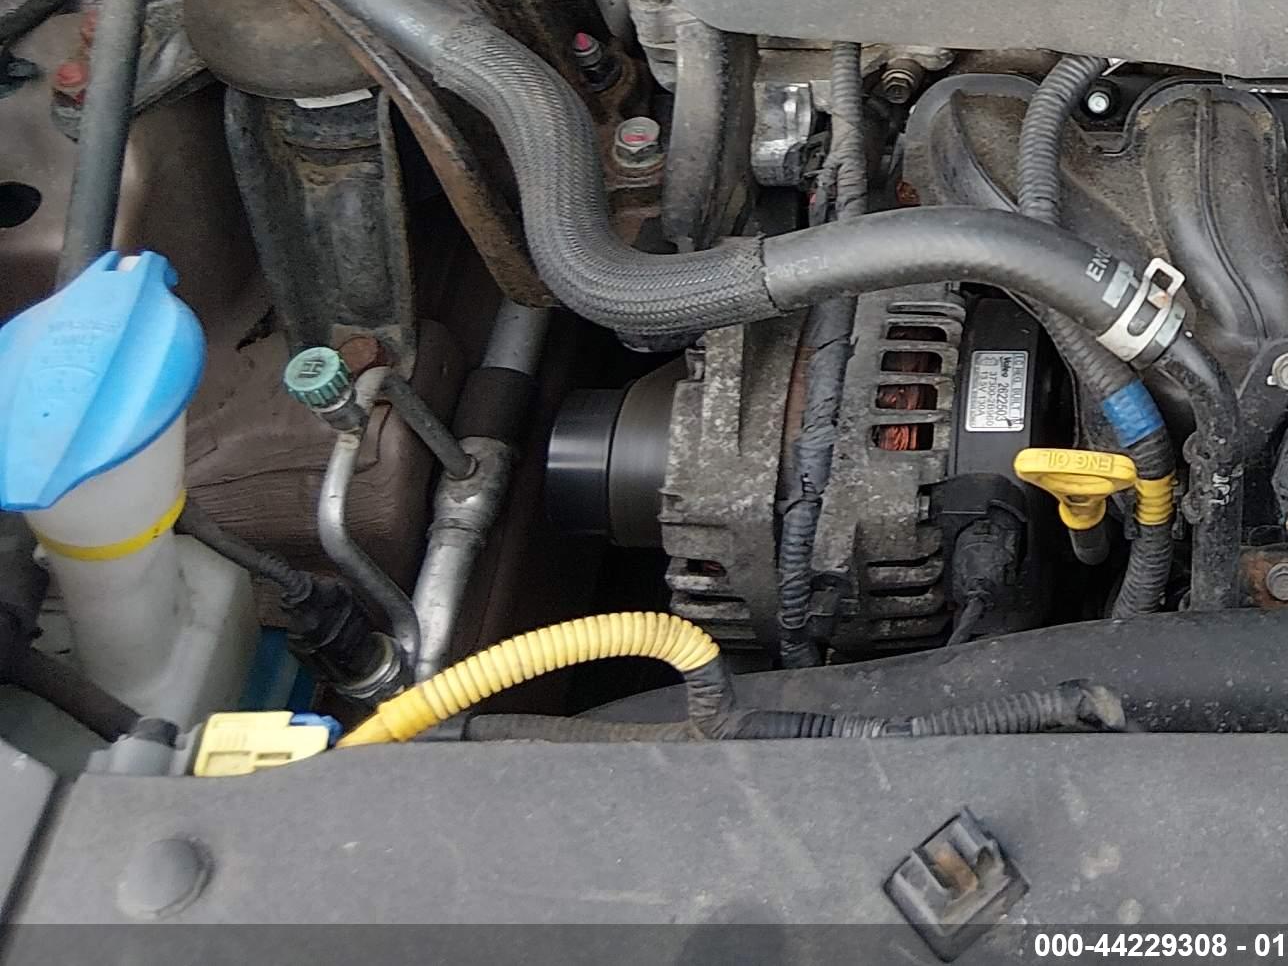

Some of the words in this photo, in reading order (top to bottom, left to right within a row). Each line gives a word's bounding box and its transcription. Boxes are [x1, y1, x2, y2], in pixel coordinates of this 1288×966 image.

[1000, 356, 1012, 378] Valeo
[1039, 451, 1071, 471] OIL
[1072, 454, 1114, 474] ENG
